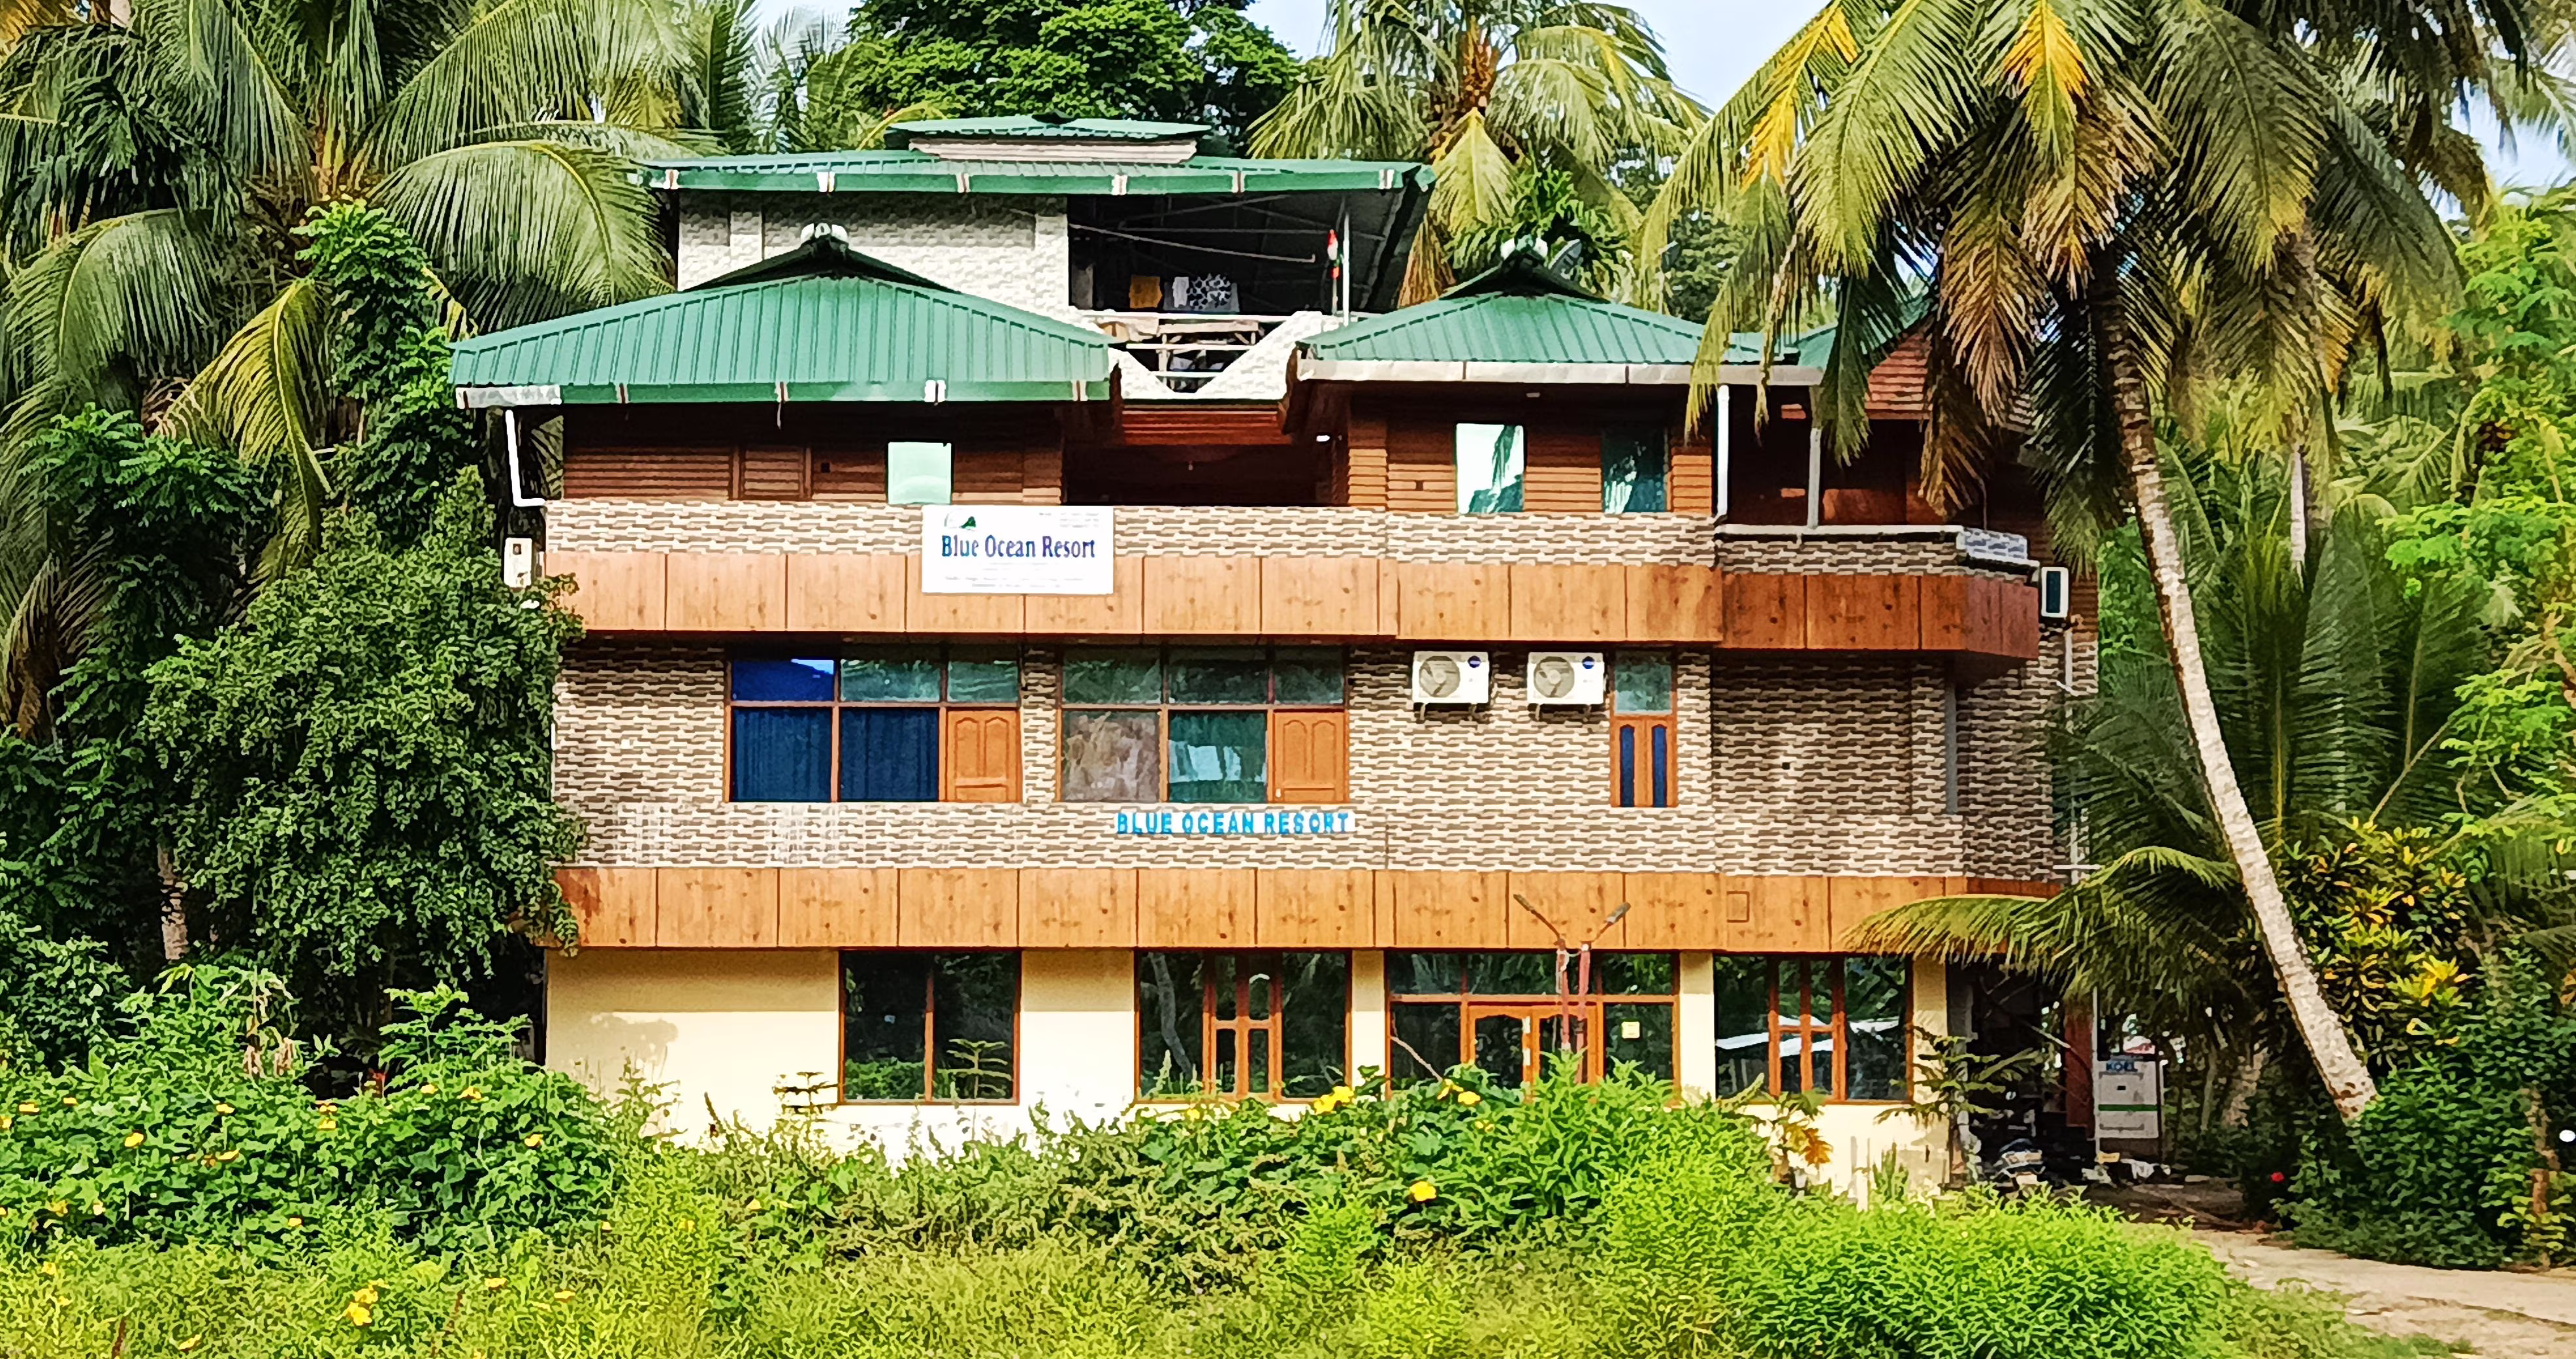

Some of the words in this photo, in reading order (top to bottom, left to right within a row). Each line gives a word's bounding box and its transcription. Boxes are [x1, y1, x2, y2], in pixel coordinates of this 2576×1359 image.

[941, 534, 979, 557] Blue
[984, 534, 1037, 558] Ocean
[1042, 535, 1095, 558] Resort
[1117, 812, 1173, 835] BLUE
[1182, 812, 1255, 835] OCEAN
[1264, 812, 1349, 835] RESORT
